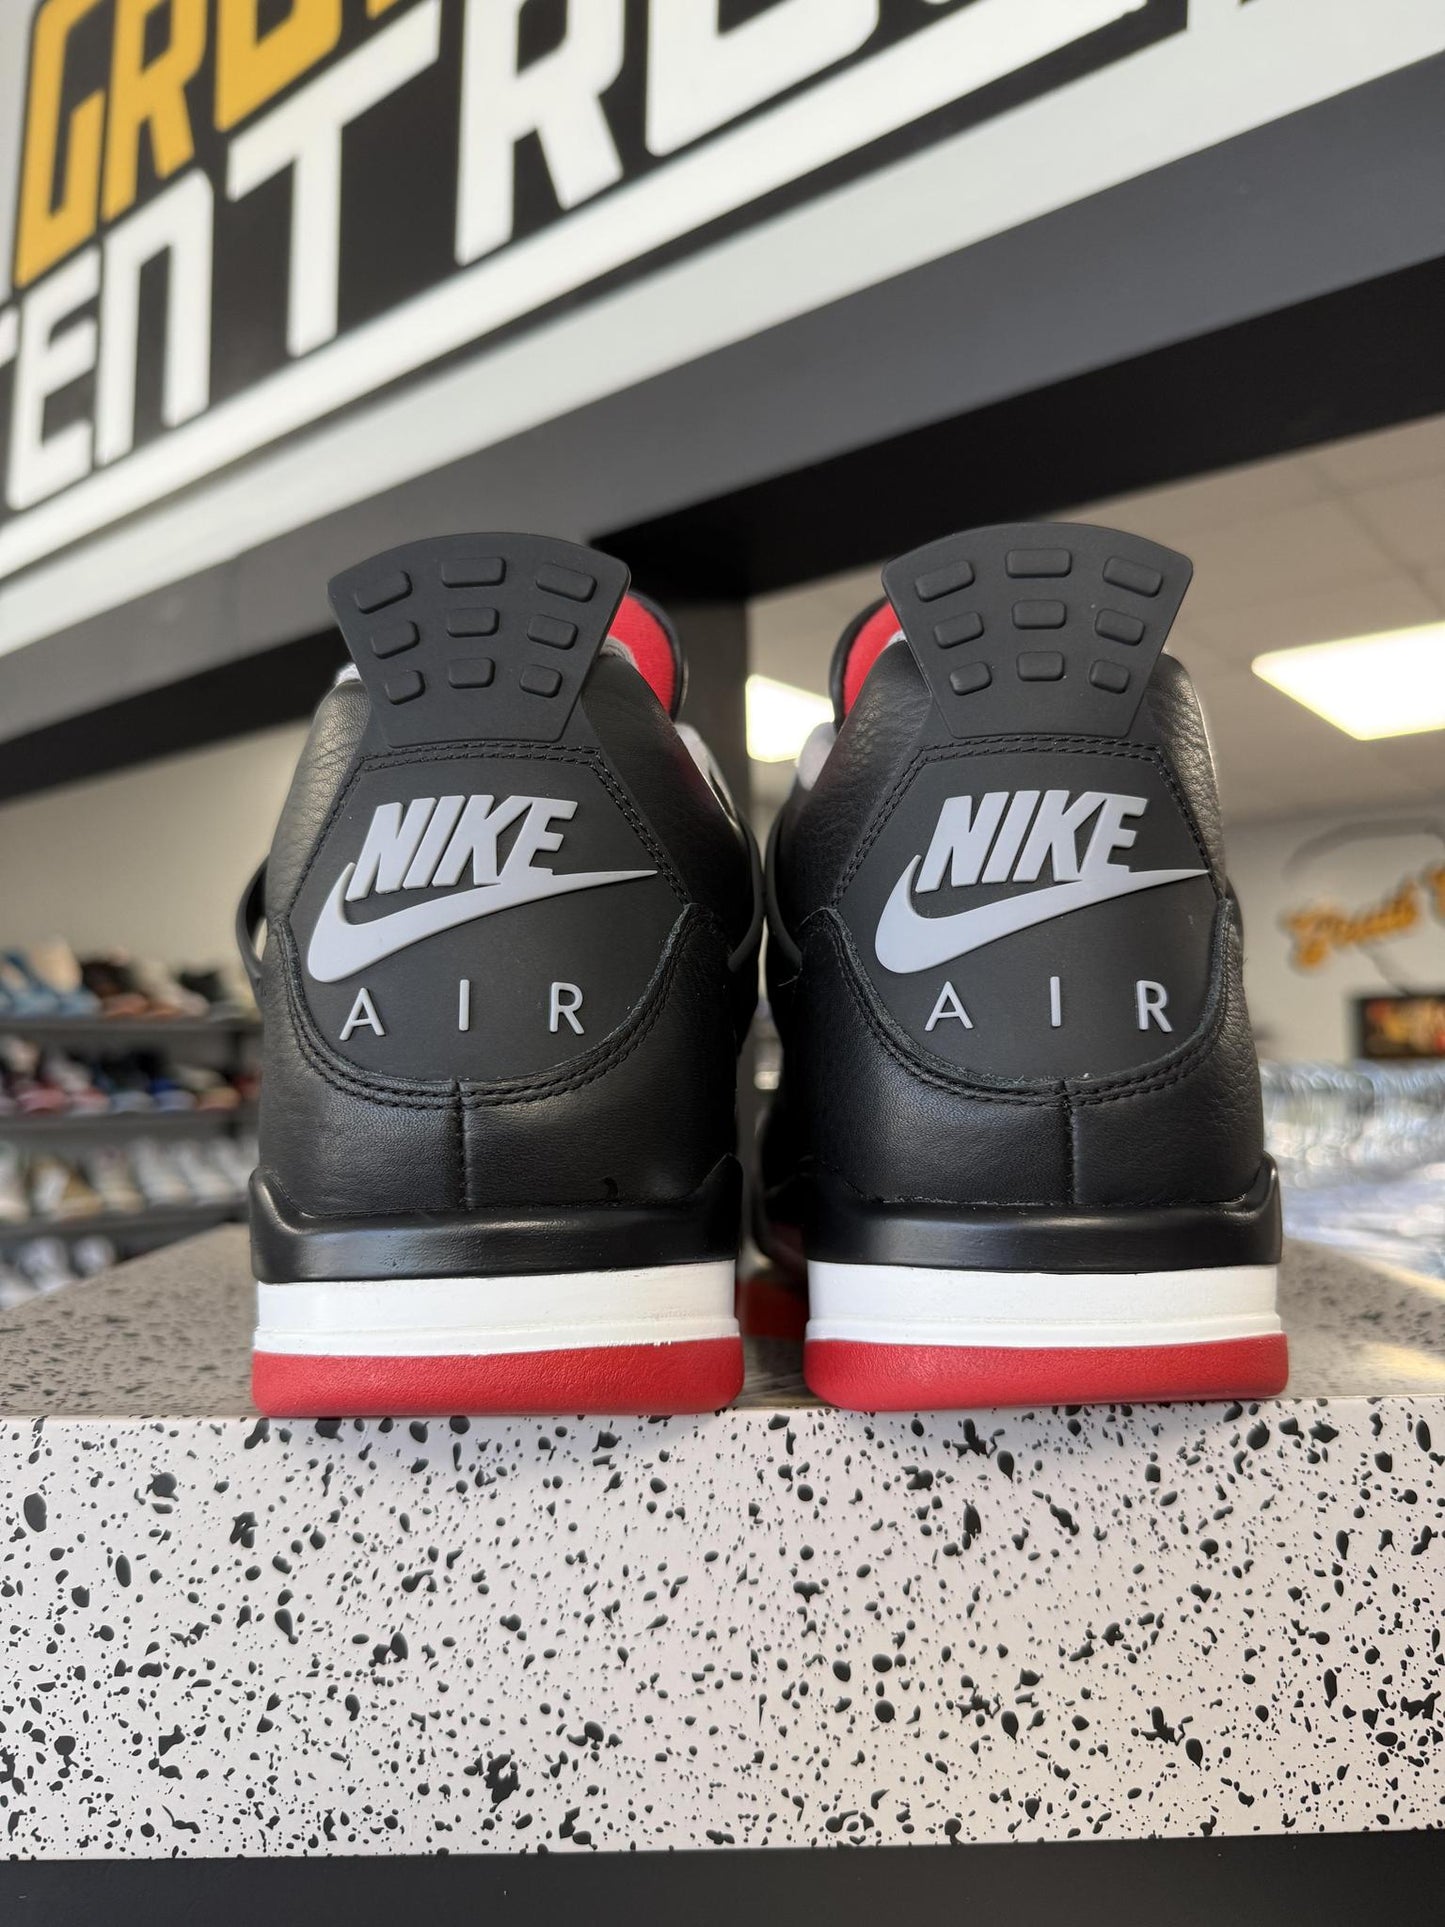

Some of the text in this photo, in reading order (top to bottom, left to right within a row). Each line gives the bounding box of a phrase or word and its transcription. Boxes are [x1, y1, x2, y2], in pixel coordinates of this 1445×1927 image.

[345, 794, 578, 901] NIKE
[915, 789, 1148, 893] NIKE
[338, 978, 585, 1041] AIR
[923, 975, 1173, 1033] AIR
